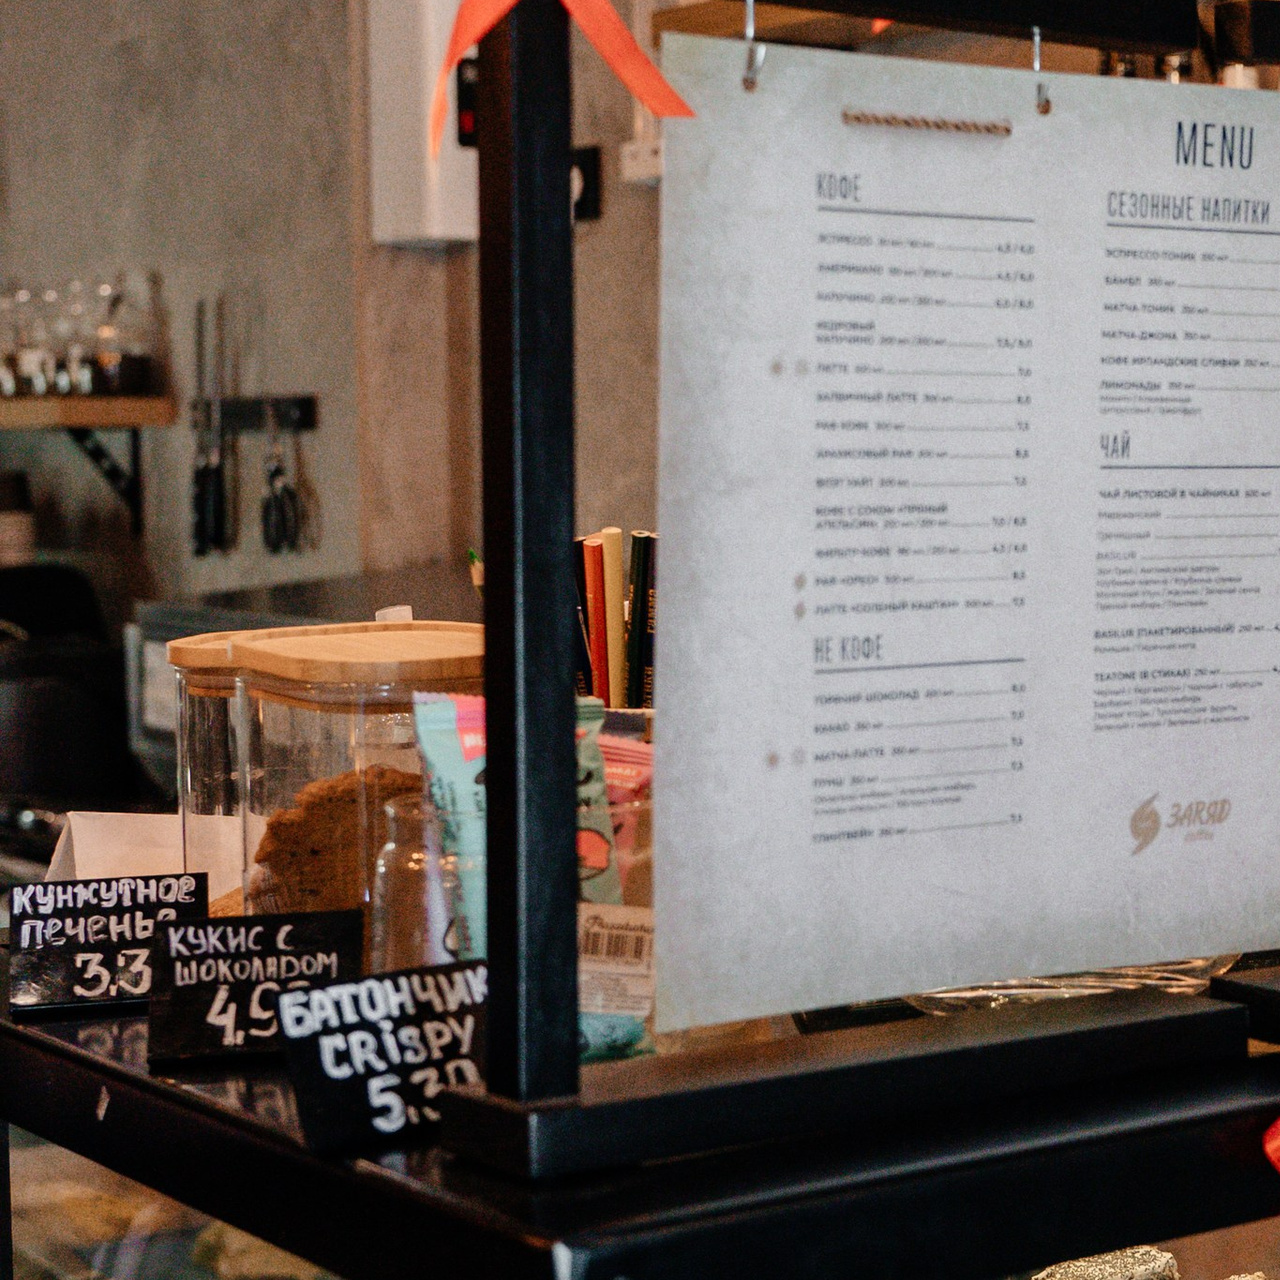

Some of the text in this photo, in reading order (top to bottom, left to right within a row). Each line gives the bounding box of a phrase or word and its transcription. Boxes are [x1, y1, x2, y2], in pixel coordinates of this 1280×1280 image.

[1175, 121, 1254, 170] MENU
[816, 173, 860, 202] КОФЕ
[1106, 190, 1270, 224] СЕЗОННЫЕ НАПИТКИ
[1100, 431, 1130, 457] ЧАЙ
[813, 634, 882, 662] НЕ КОФЕ
[278, 966, 488, 1039] БАТОНЧИК
